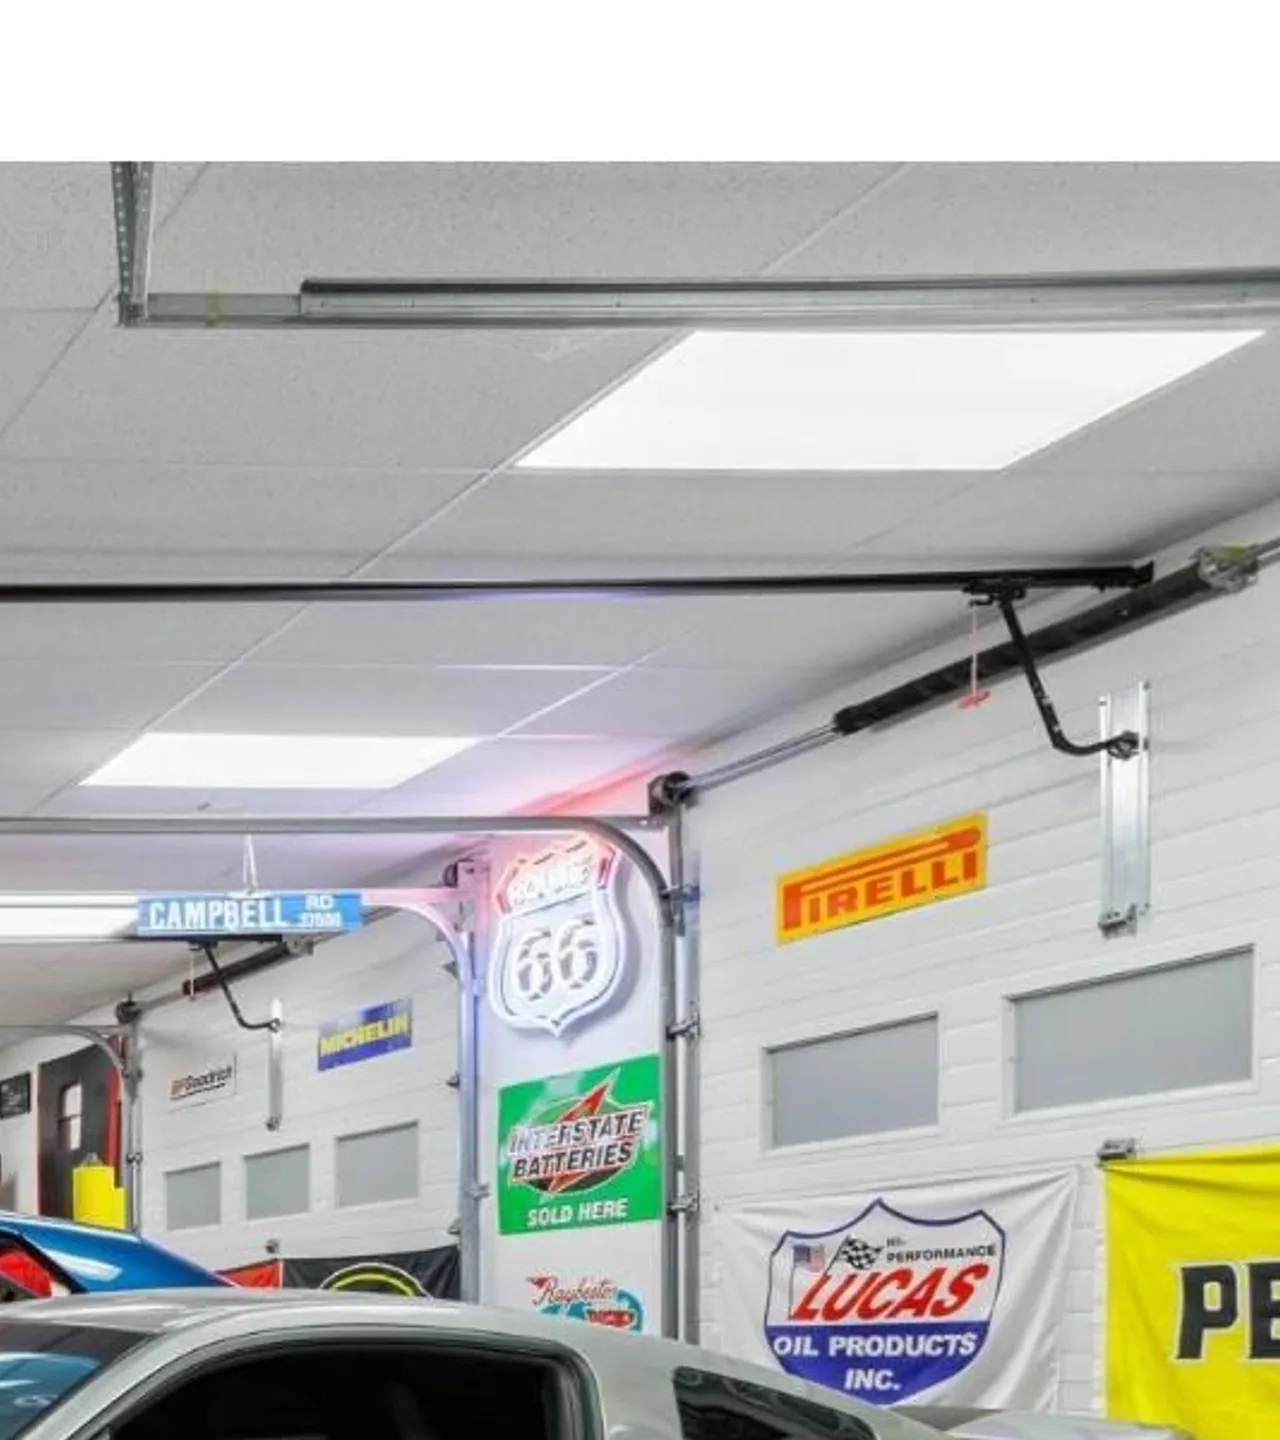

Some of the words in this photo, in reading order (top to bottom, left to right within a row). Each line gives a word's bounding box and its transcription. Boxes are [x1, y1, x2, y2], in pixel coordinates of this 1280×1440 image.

[782, 825, 982, 930] PIRELLI
[149, 897, 288, 932] CAMPBELL
[305, 893, 335, 910] RD
[512, 915, 598, 1003] 66
[320, 1013, 408, 1055] MICHELIN
[509, 1110, 644, 1155] INTERSTATE
[513, 1141, 633, 1178] BATTERIES
[526, 1205, 573, 1228] SOLD
[577, 1199, 629, 1222] HERE
[886, 1244, 997, 1263] PERFORMANCE
[789, 1262, 990, 1321] LUCAS
[773, 1335, 820, 1356] OIL
[828, 1333, 978, 1356] PRODUCTS
[844, 1368, 902, 1391] INC.
